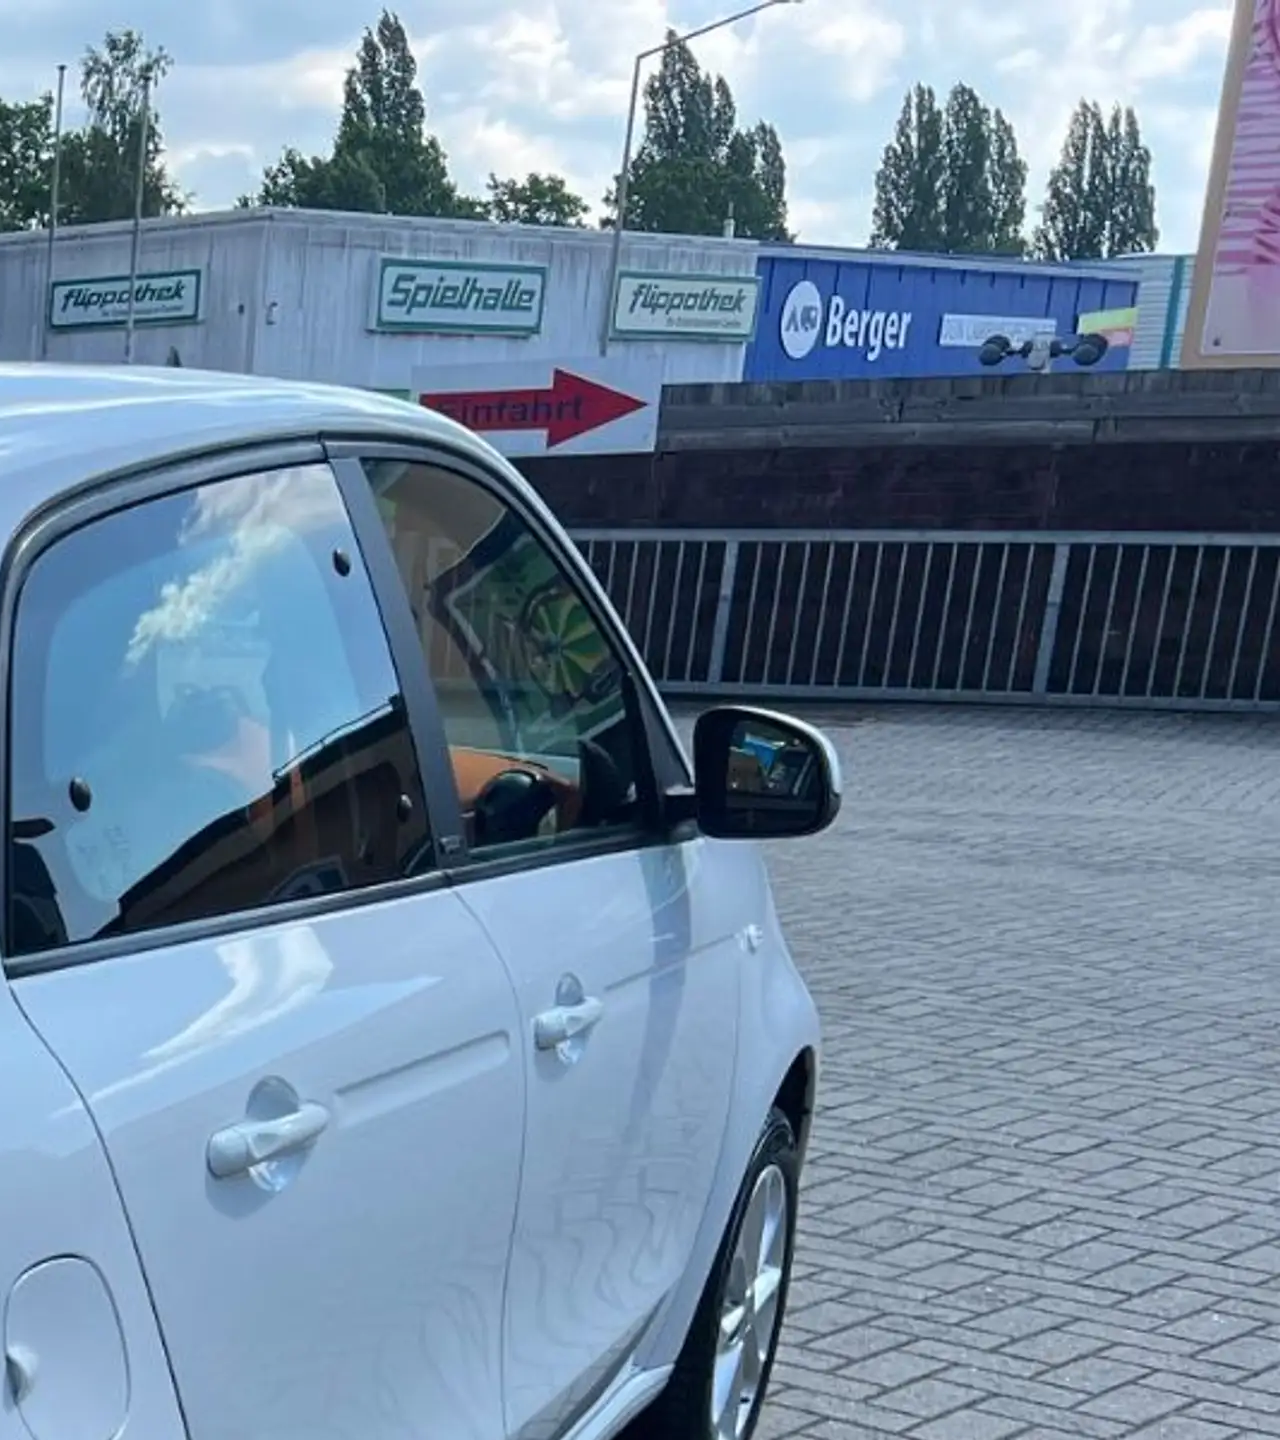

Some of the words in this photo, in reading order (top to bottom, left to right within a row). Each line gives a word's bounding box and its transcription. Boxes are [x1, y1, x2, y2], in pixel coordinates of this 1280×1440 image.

[386, 273, 536, 315] Spielhalle
[629, 283, 746, 315] flippothek
[826, 296, 911, 361] Berger
